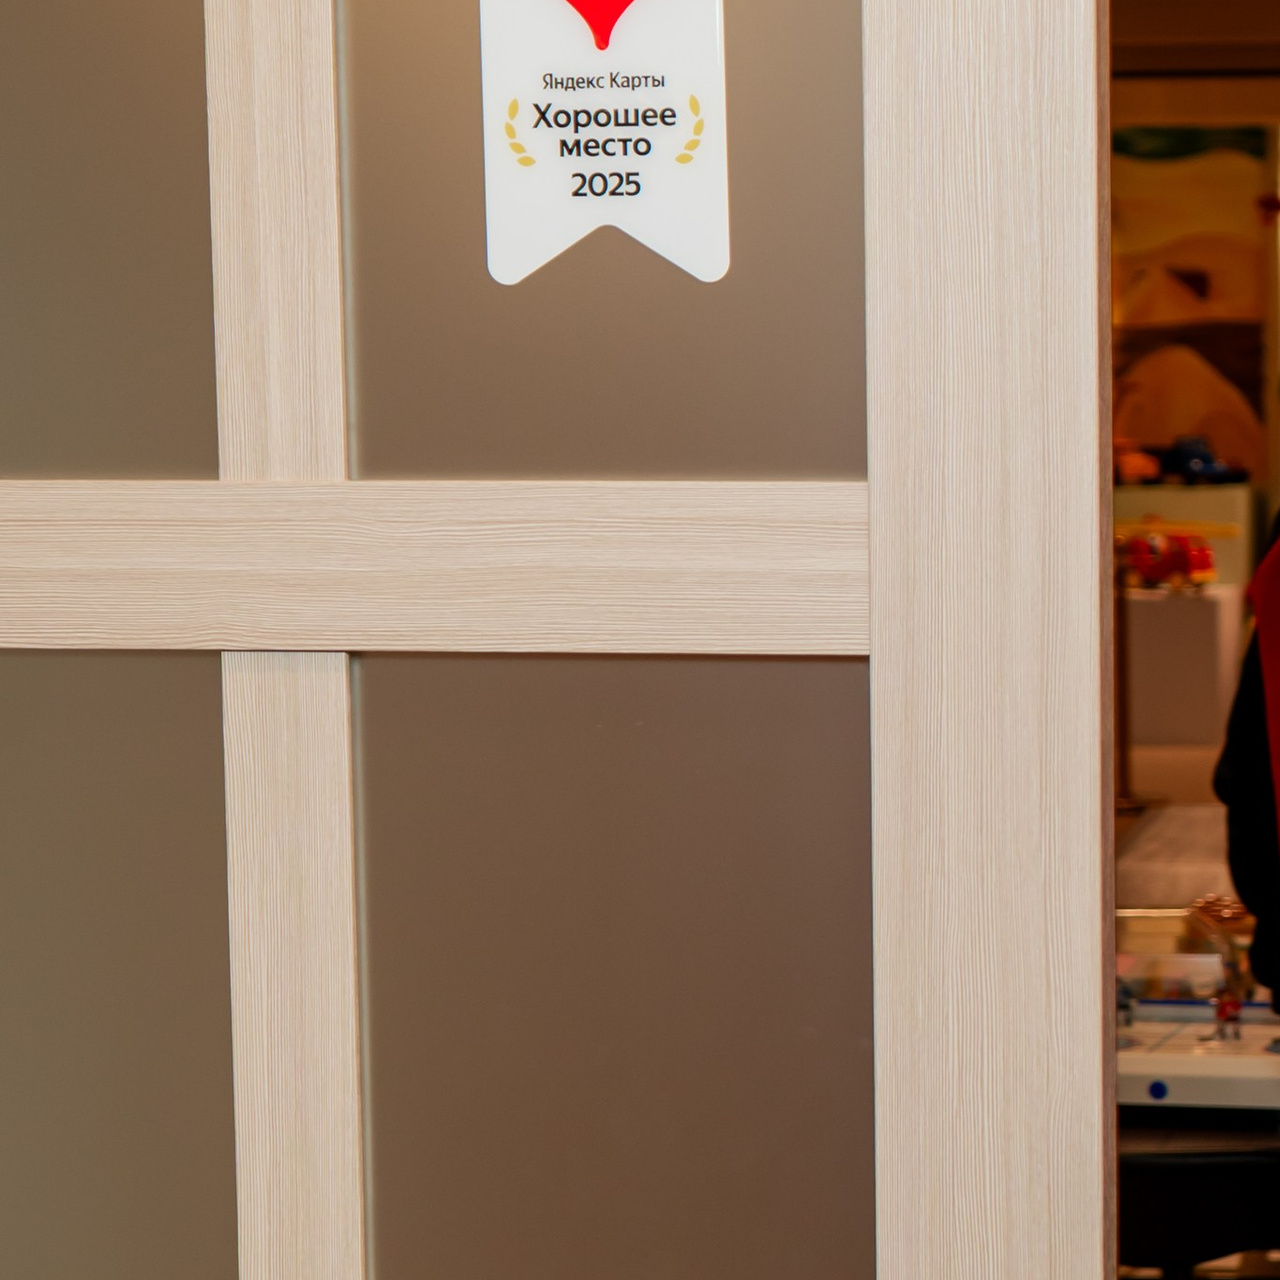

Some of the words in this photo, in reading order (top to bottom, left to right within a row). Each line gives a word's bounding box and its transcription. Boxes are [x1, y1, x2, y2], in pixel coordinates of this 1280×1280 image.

[541, 73, 605, 92] Яндекс
[609, 71, 665, 91] Карты
[532, 102, 678, 134] Хорошее
[559, 137, 652, 158] место
[571, 171, 641, 197] 2025
